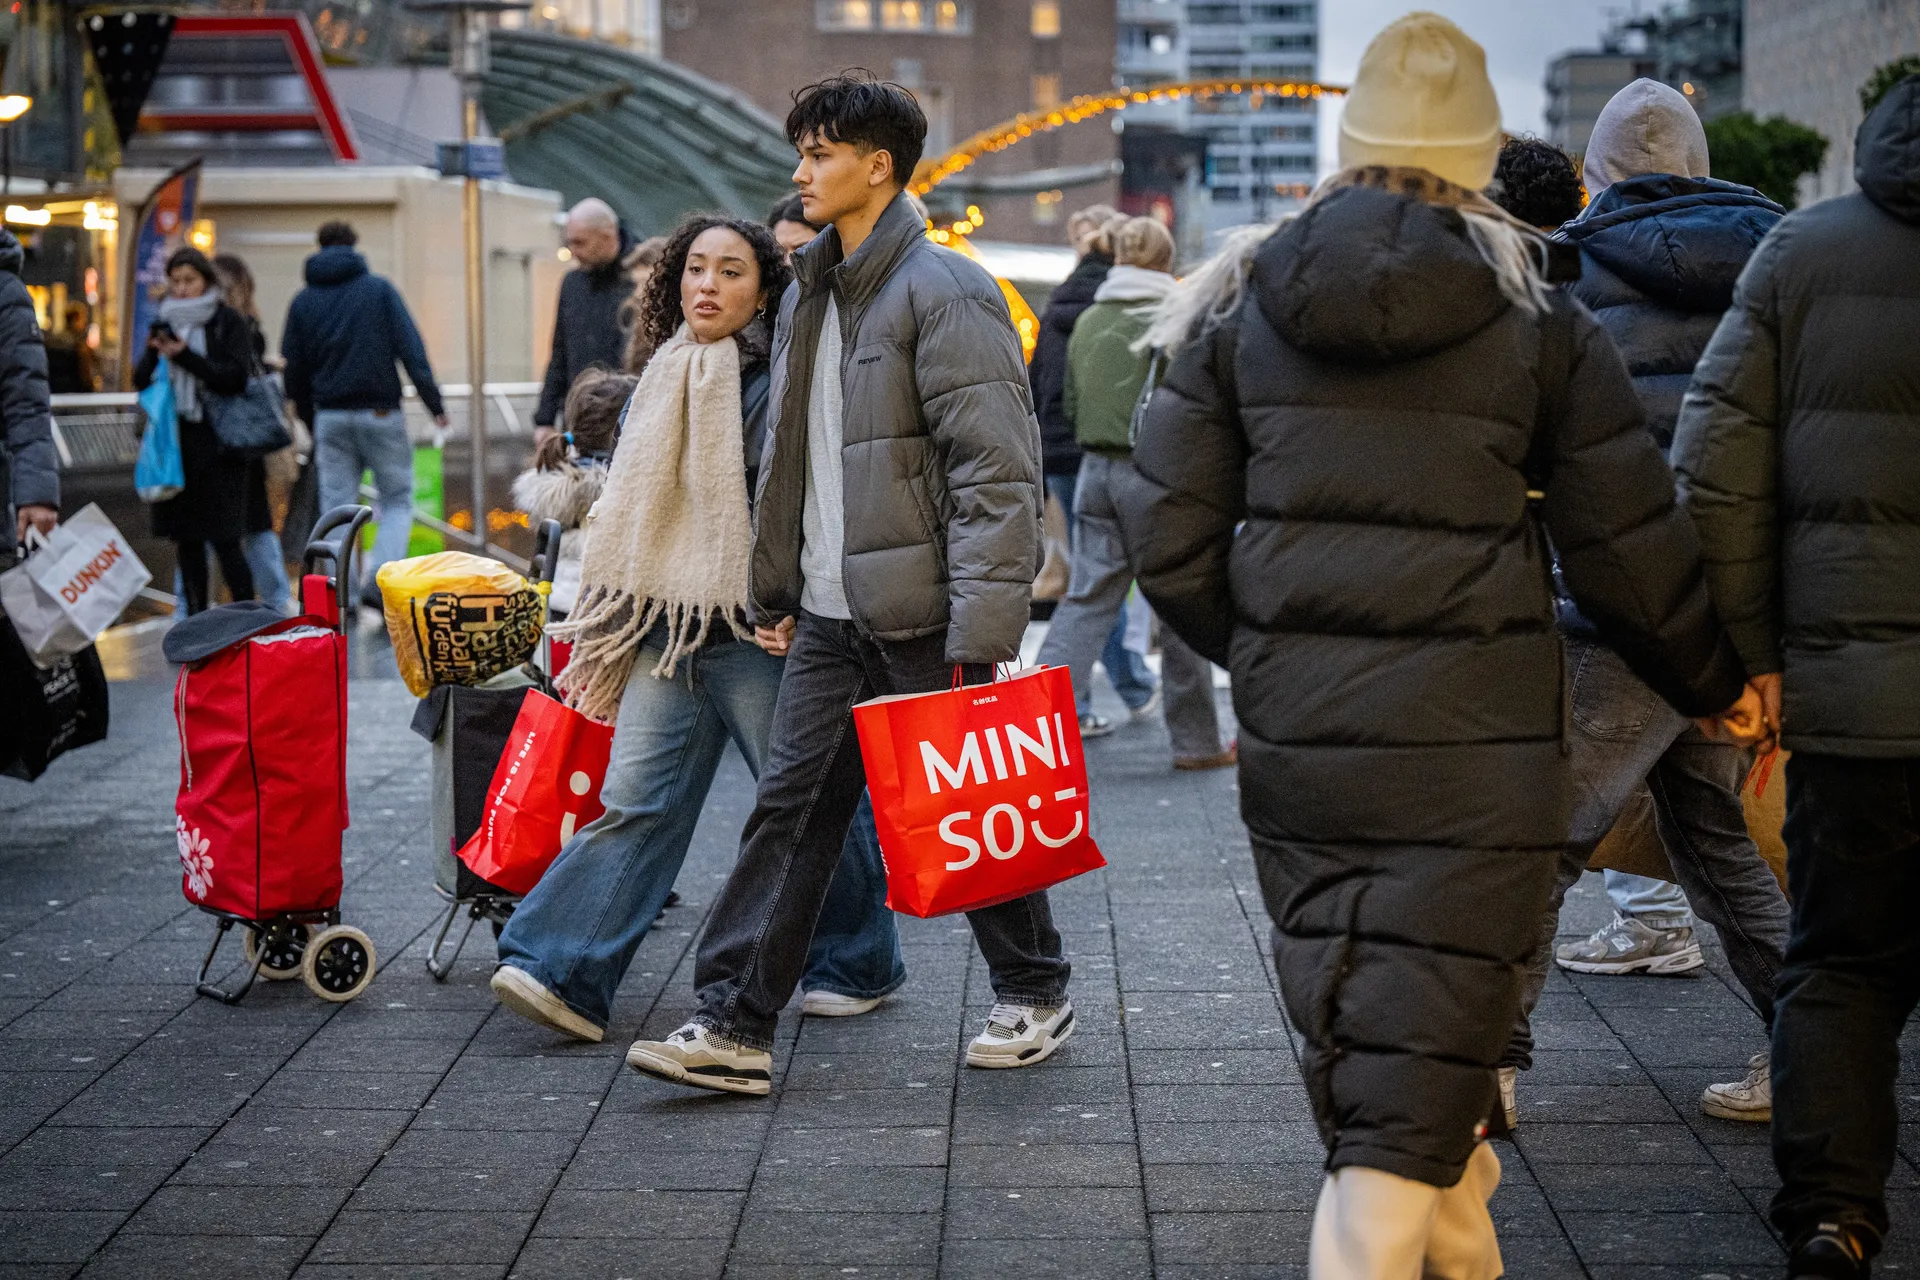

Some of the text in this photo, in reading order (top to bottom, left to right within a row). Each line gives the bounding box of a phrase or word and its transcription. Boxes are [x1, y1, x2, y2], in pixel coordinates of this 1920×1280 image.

[518, 731, 536, 759] LIFE
[918, 711, 1071, 794] MINI
[510, 761, 521, 775] IS
[494, 777, 512, 807] FOR
